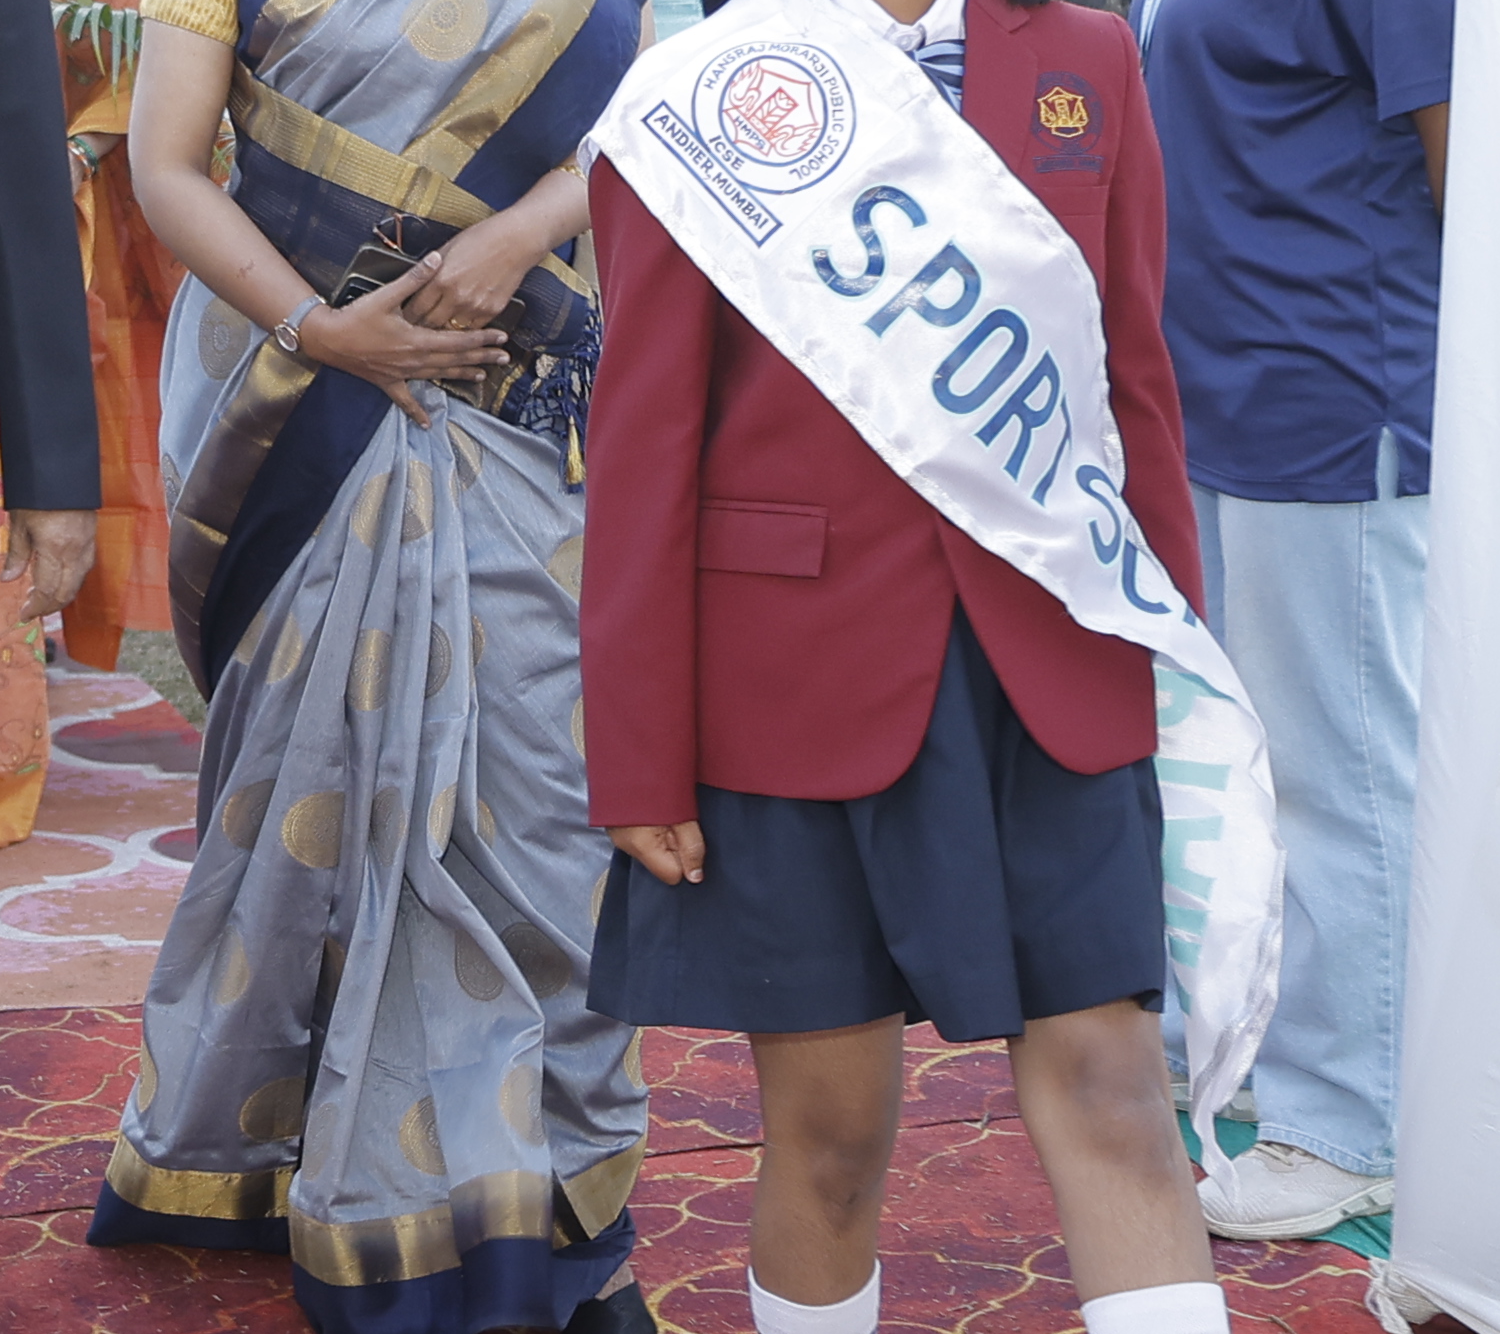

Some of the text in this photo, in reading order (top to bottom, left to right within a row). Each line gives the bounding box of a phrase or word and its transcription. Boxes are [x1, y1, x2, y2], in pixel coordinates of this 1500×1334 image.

[703, 42, 846, 181] HANSRAJ MORARJI PUBLIC SCHOOL
[708, 134, 745, 171] ICSE
